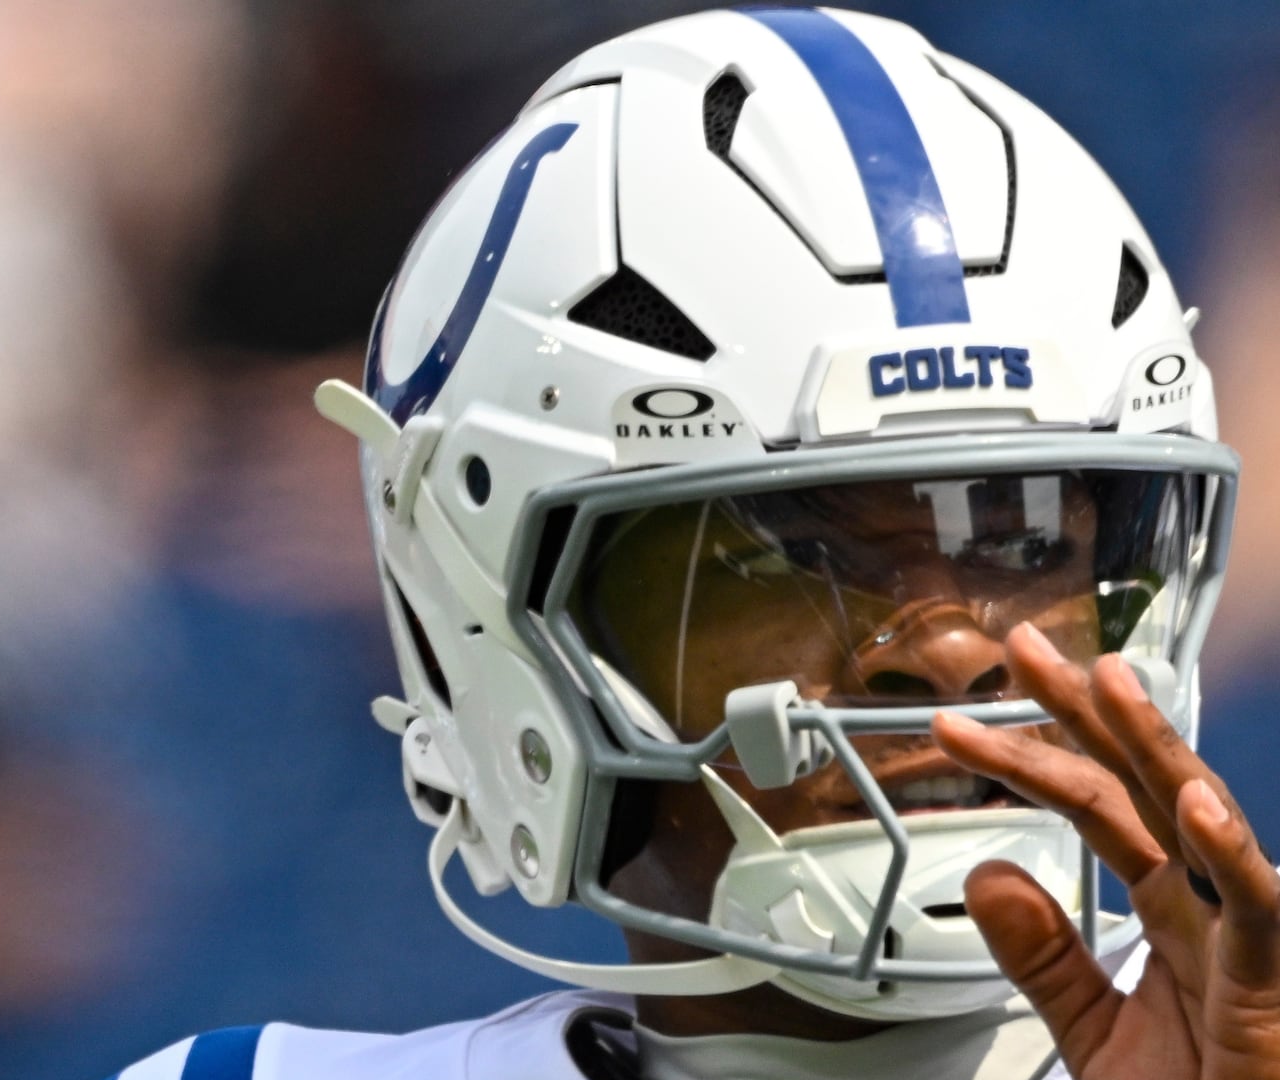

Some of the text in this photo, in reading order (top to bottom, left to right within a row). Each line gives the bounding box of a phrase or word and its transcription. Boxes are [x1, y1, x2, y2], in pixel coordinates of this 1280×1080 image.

[869, 345, 1033, 397] COLTS
[1132, 384, 1193, 412] OAKLEY
[616, 422, 736, 438] OAKLEY
